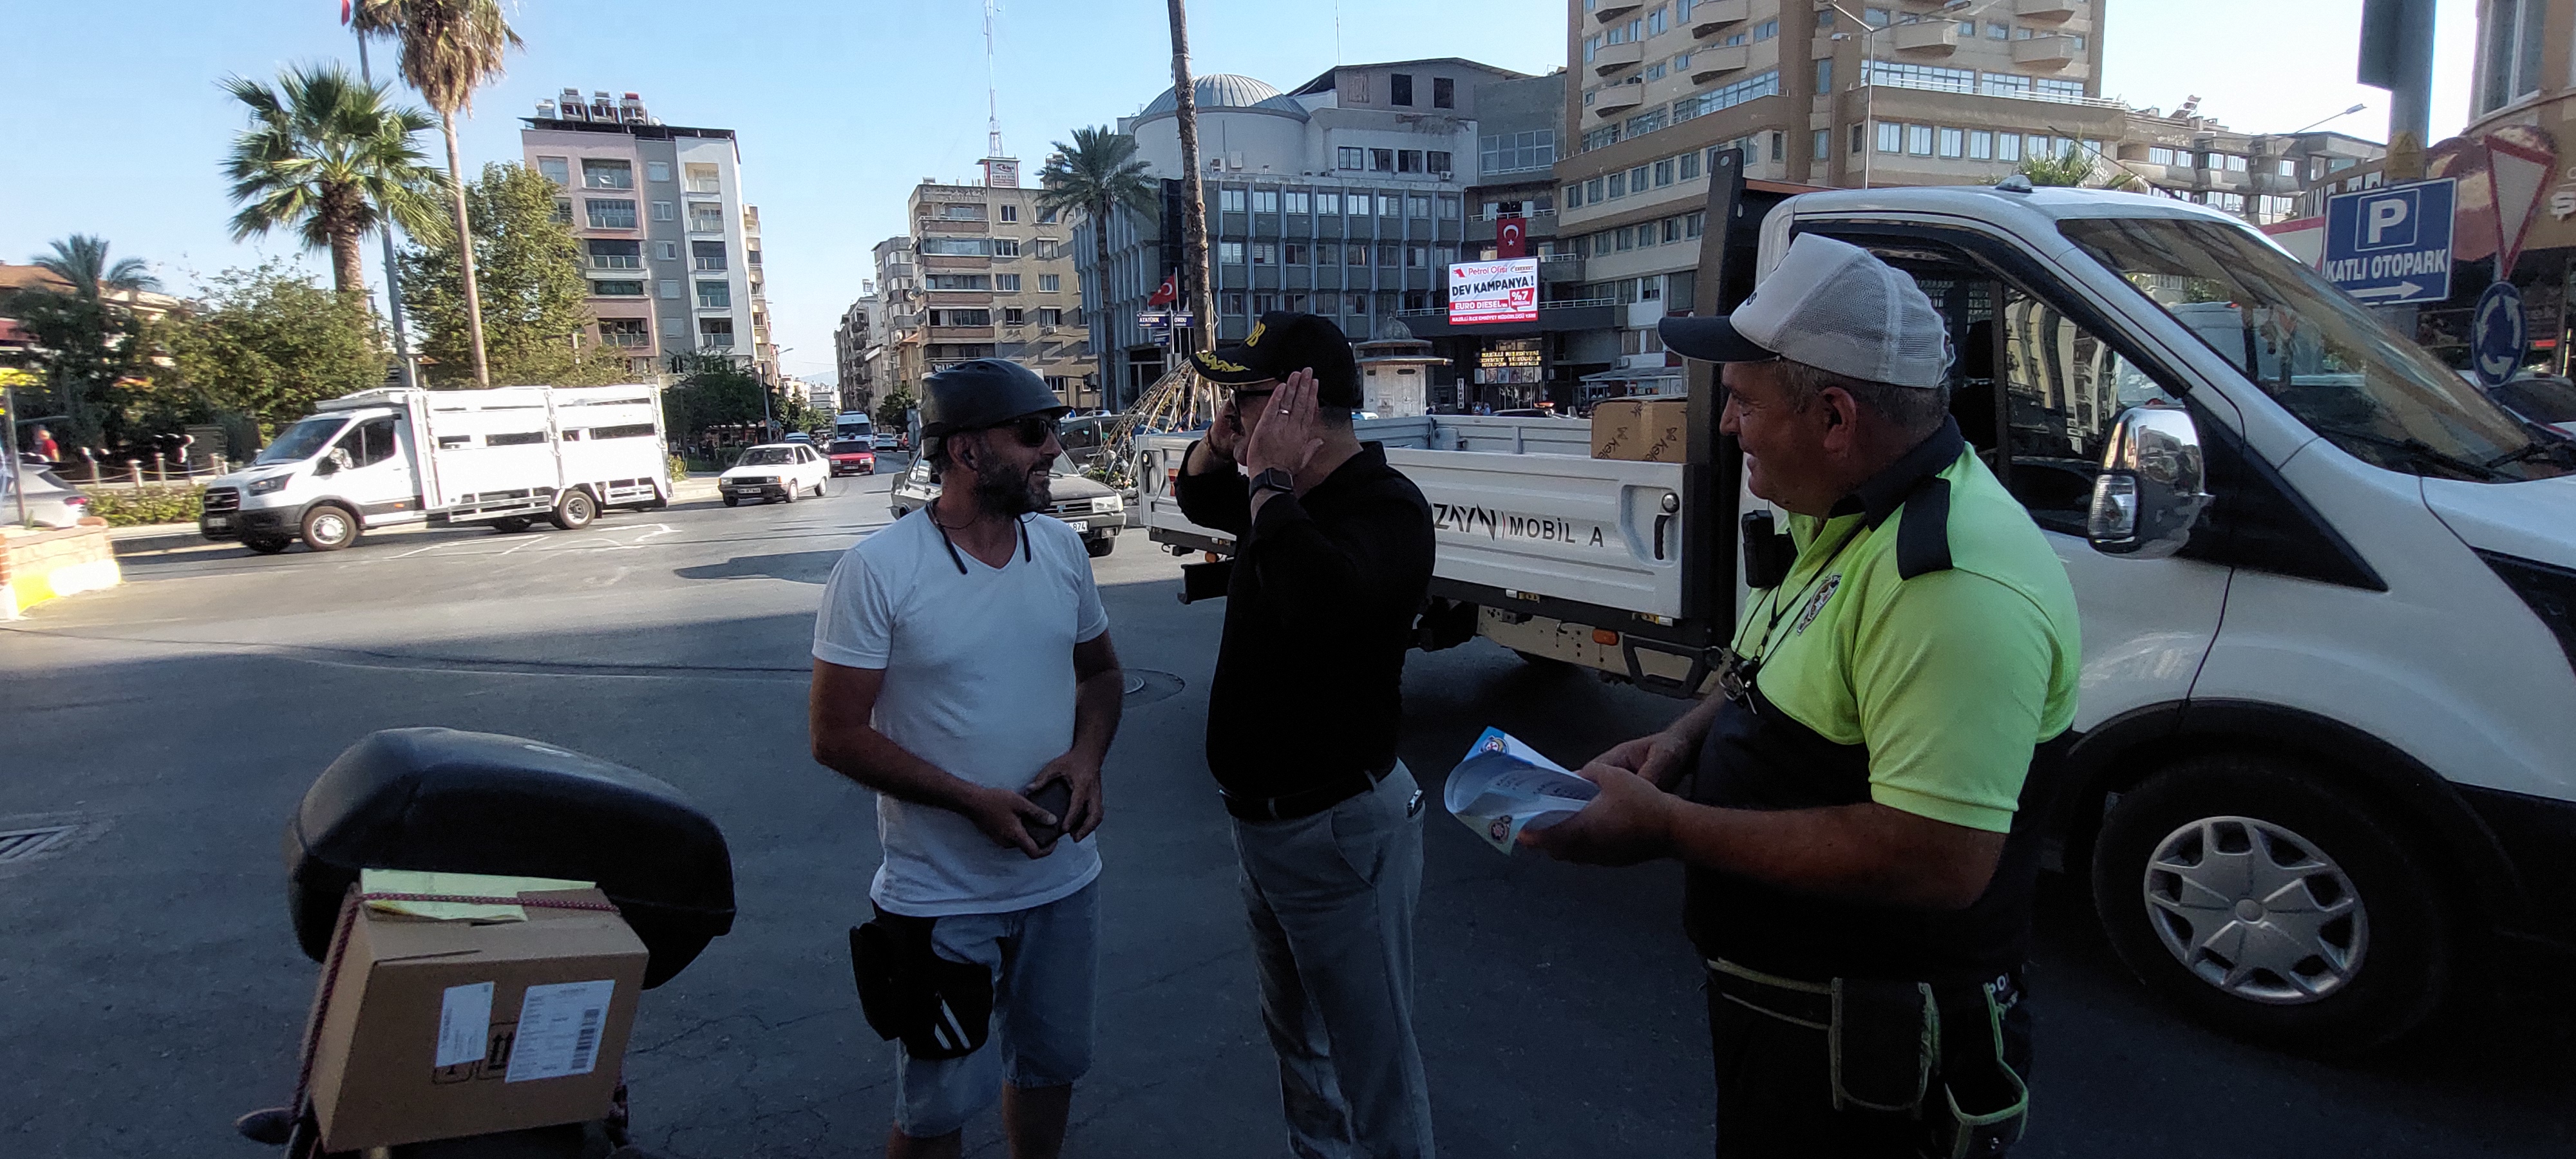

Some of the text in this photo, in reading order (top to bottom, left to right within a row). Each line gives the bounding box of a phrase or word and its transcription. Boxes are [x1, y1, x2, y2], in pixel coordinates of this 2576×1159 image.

[2367, 198, 2407, 245] P
[1468, 267, 1489, 276] Petrol
[2326, 249, 2447, 282] KATLI OTOPARK
[1452, 284, 1471, 296] DEV
[1473, 276, 1530, 294] KAMPANYA
[1511, 290, 1529, 301] %7
[1073, 522, 1086, 532] 874
[1429, 502, 1497, 542] ZAYN
